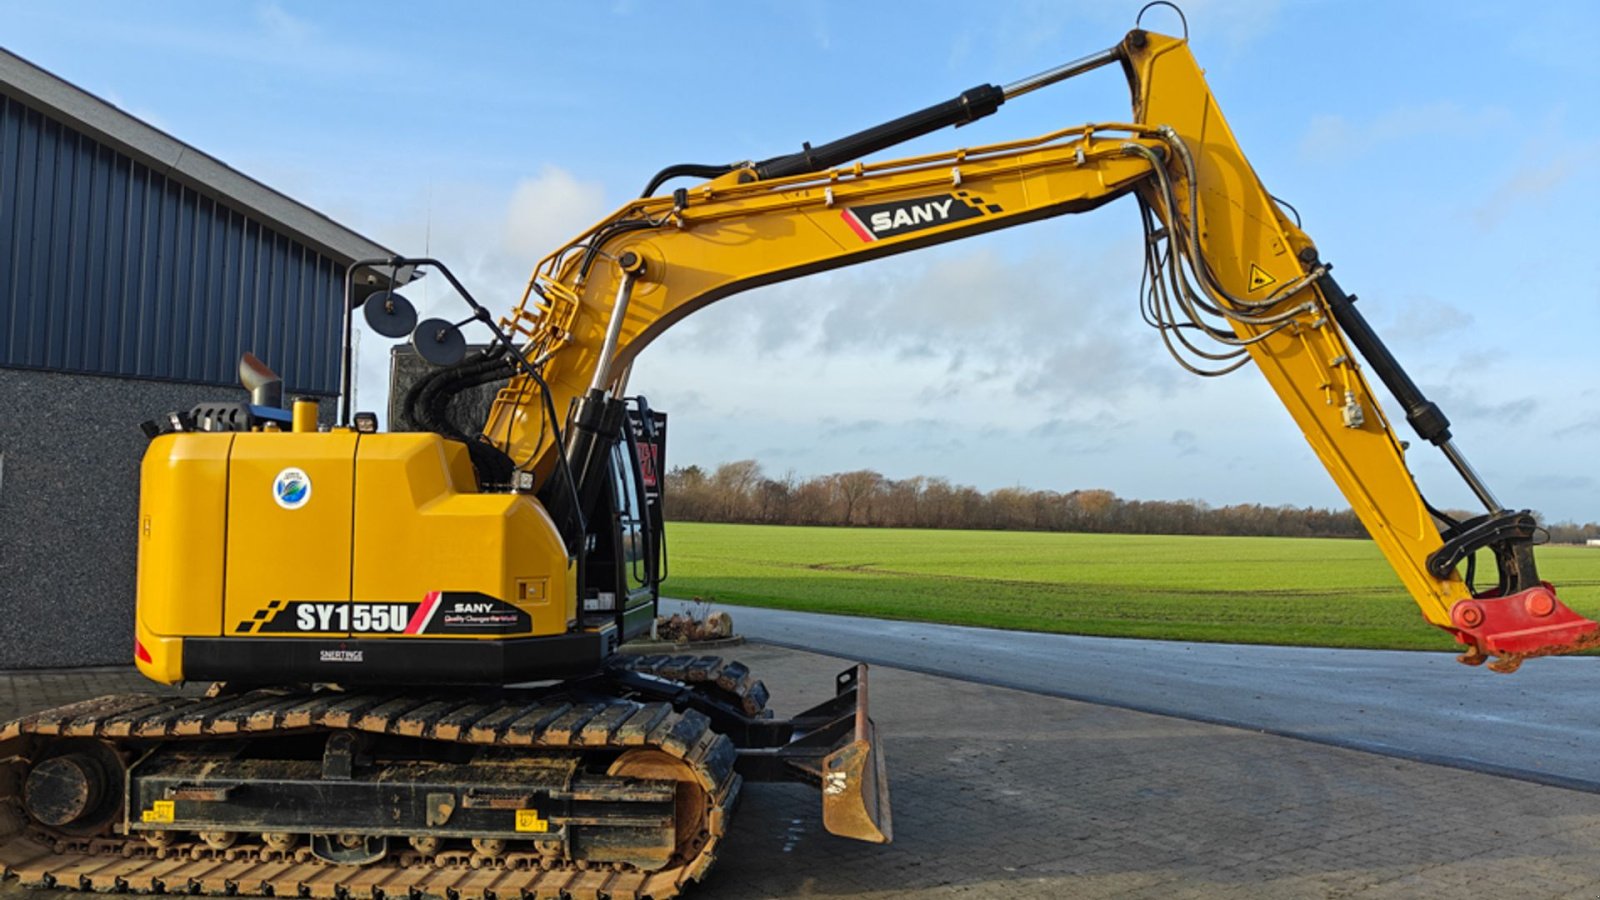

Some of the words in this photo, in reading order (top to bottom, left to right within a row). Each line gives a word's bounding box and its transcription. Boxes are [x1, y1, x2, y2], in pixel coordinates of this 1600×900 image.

[870, 198, 953, 233] SANY
[296, 603, 409, 632] SY155U
[454, 603, 494, 613] SANY
